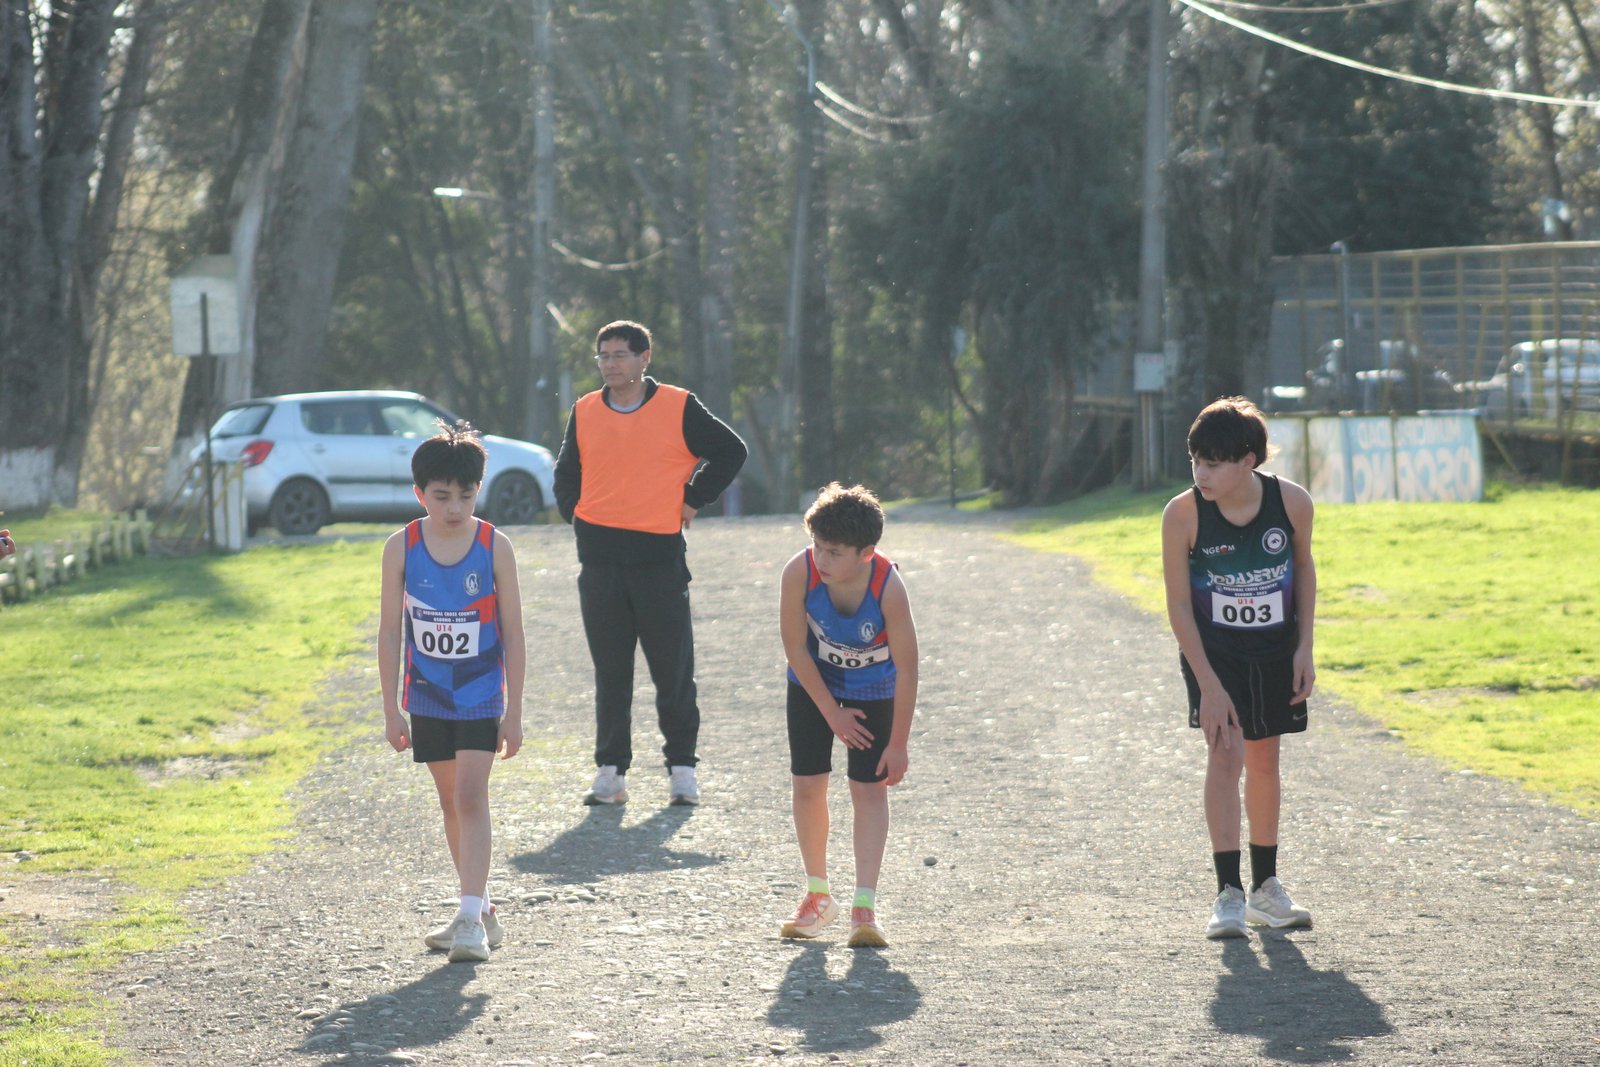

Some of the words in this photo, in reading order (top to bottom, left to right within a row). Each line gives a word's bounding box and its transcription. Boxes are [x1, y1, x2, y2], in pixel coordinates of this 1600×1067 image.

[1222, 604, 1272, 624] 003
[436, 624, 453, 632] U14
[421, 631, 470, 655] 002
[828, 652, 875, 668] 001
